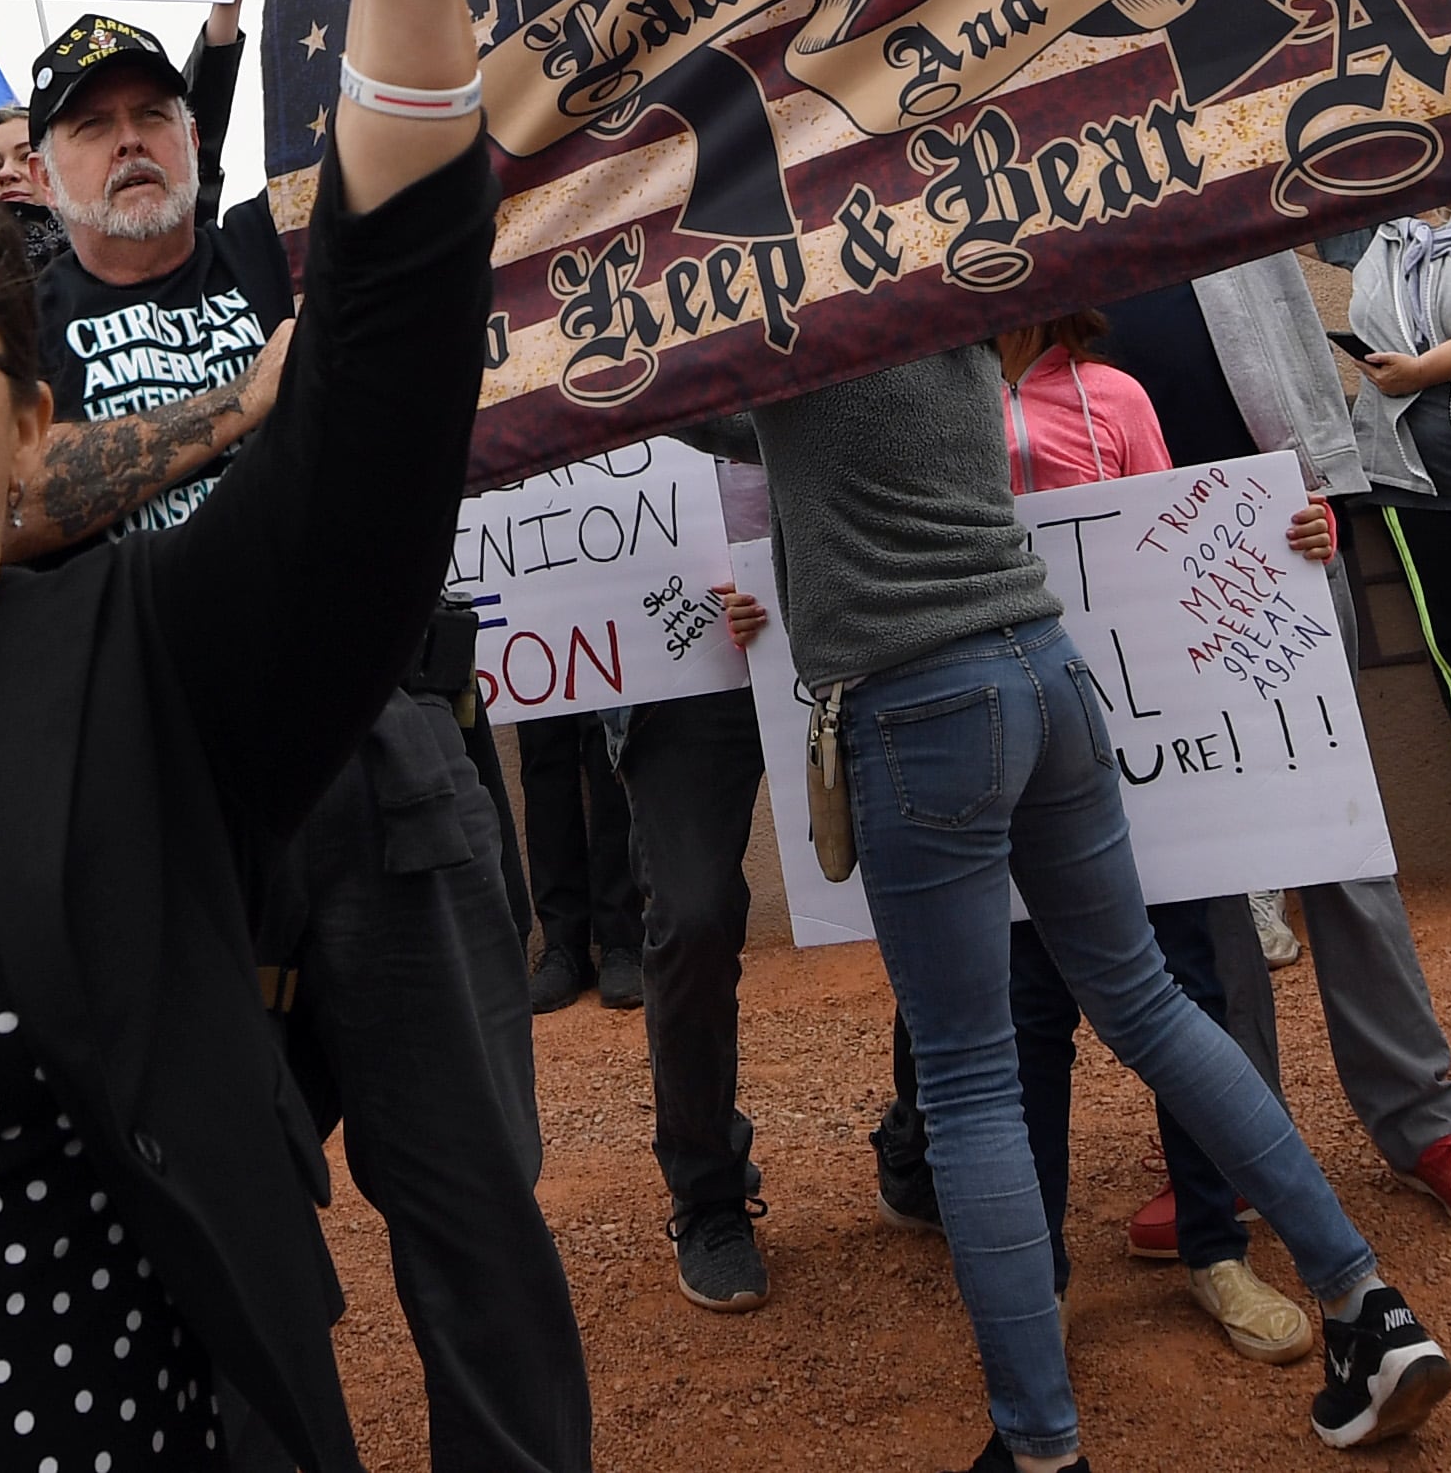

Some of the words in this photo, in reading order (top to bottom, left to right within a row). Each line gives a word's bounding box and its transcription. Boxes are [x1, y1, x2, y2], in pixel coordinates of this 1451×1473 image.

[94, 18, 140, 39] ARMY
[551, 225, 808, 407] Keep
[837, 183, 906, 294] &
[906, 89, 1210, 294] Bear
[1183, 477, 1272, 579] 2020!!
[662, 598, 699, 633] the
[1180, 538, 1267, 624] MAKE
[1187, 565, 1288, 674] AMERICA
[1383, 1307, 1415, 1332] NIKE
